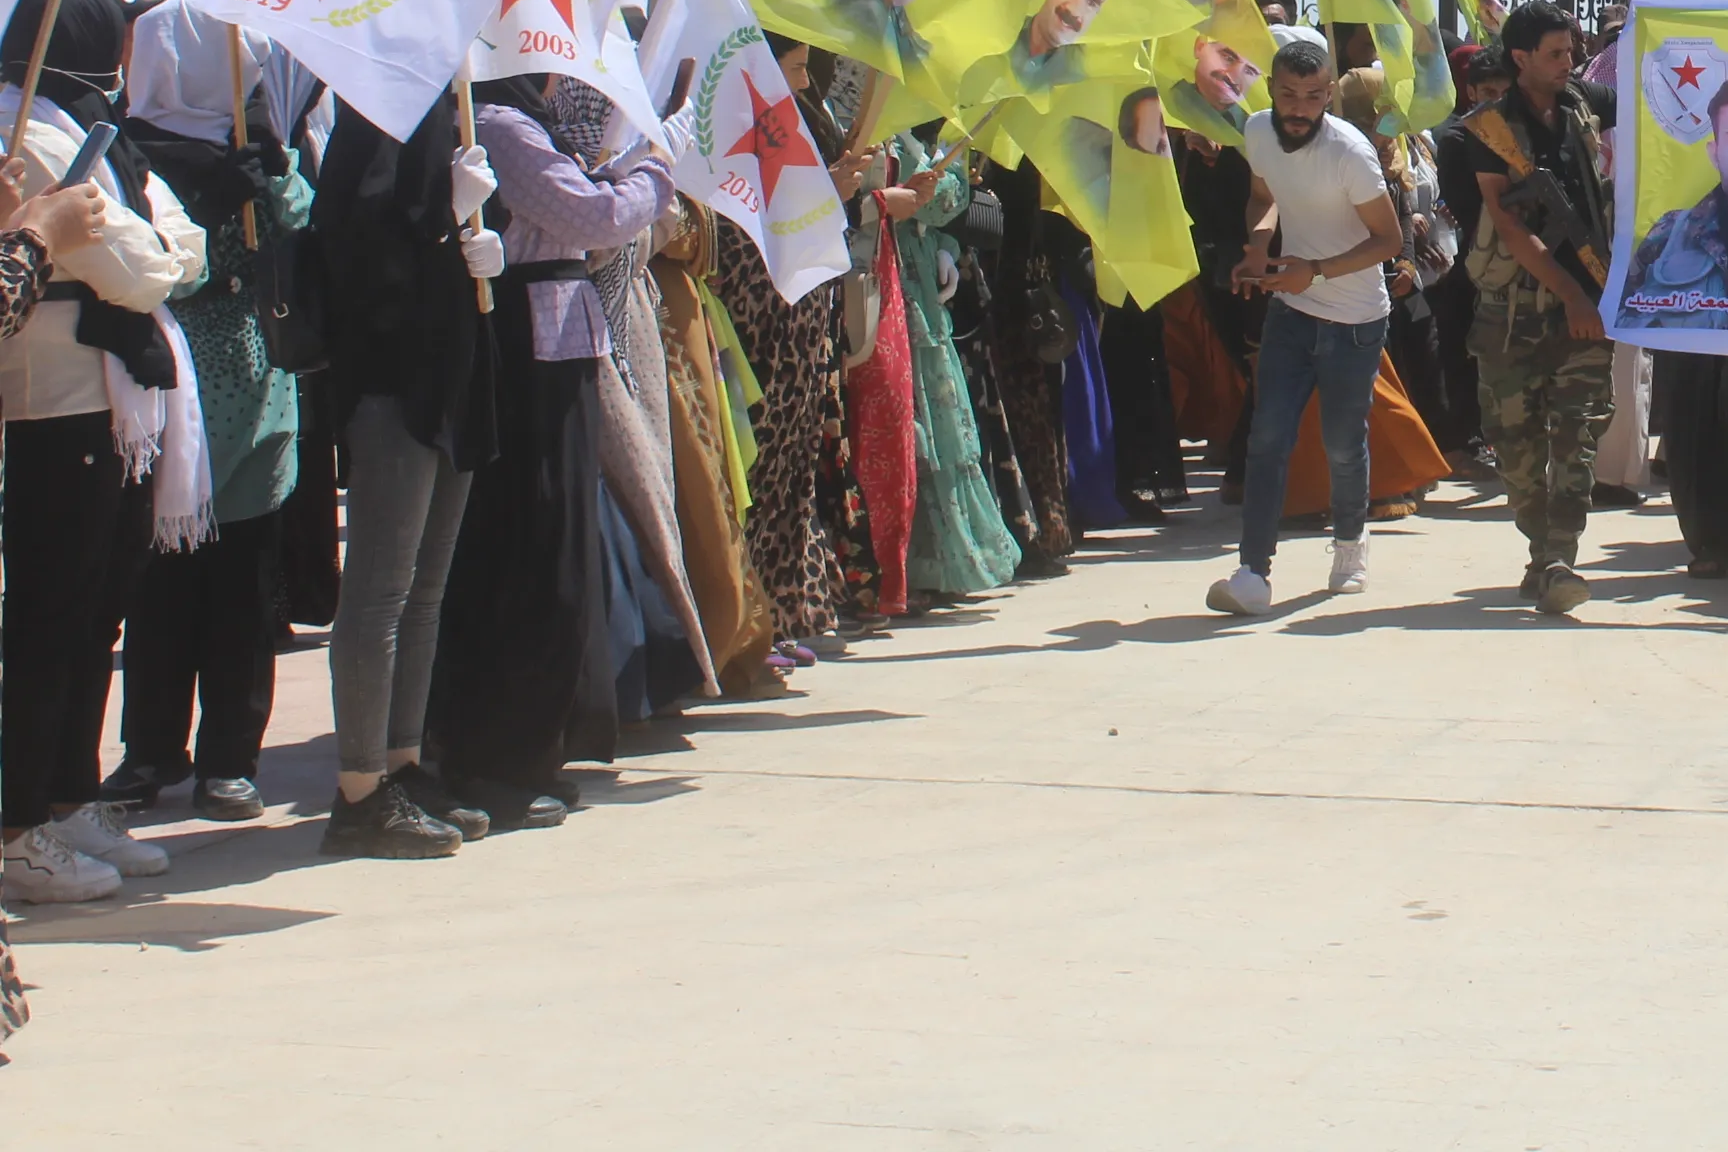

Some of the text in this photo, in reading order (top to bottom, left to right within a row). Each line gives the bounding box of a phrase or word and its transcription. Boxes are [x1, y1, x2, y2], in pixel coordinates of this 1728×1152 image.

[518, 30, 576, 60] 2003
[718, 171, 759, 213] 2019
[1627, 292, 1685, 311] العبيد
